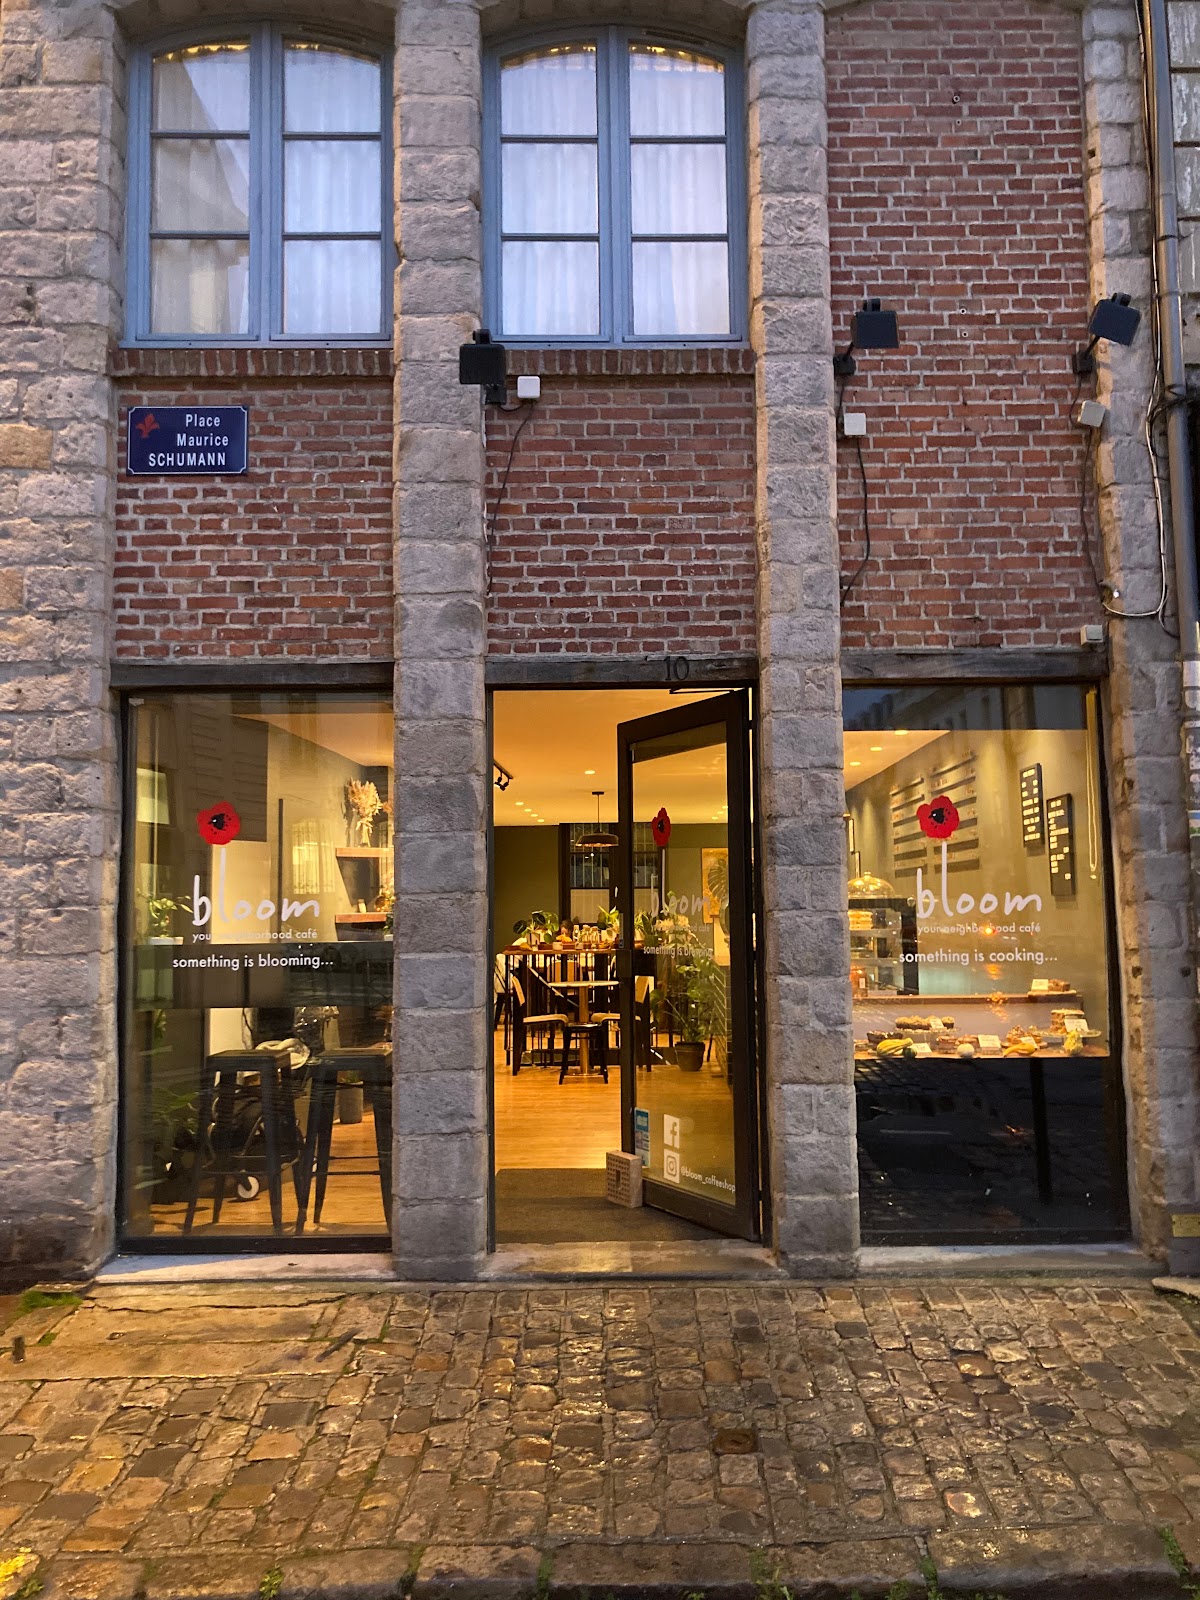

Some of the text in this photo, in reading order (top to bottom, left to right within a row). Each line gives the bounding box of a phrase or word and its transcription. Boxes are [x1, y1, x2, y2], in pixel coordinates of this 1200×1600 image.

[185, 413, 221, 427] Place
[176, 433, 229, 447] Maurice
[148, 452, 226, 467] SCHUMANN
[663, 656, 690, 681] 10
[192, 847, 320, 926] bloom
[916, 841, 1043, 919] bloom
[192, 932, 216, 944] you
[295, 927, 318, 939] café
[917, 922, 1041, 936] your neighbohood café
[172, 953, 334, 971] something is blooming...
[898, 947, 1058, 966] something is cooking...
